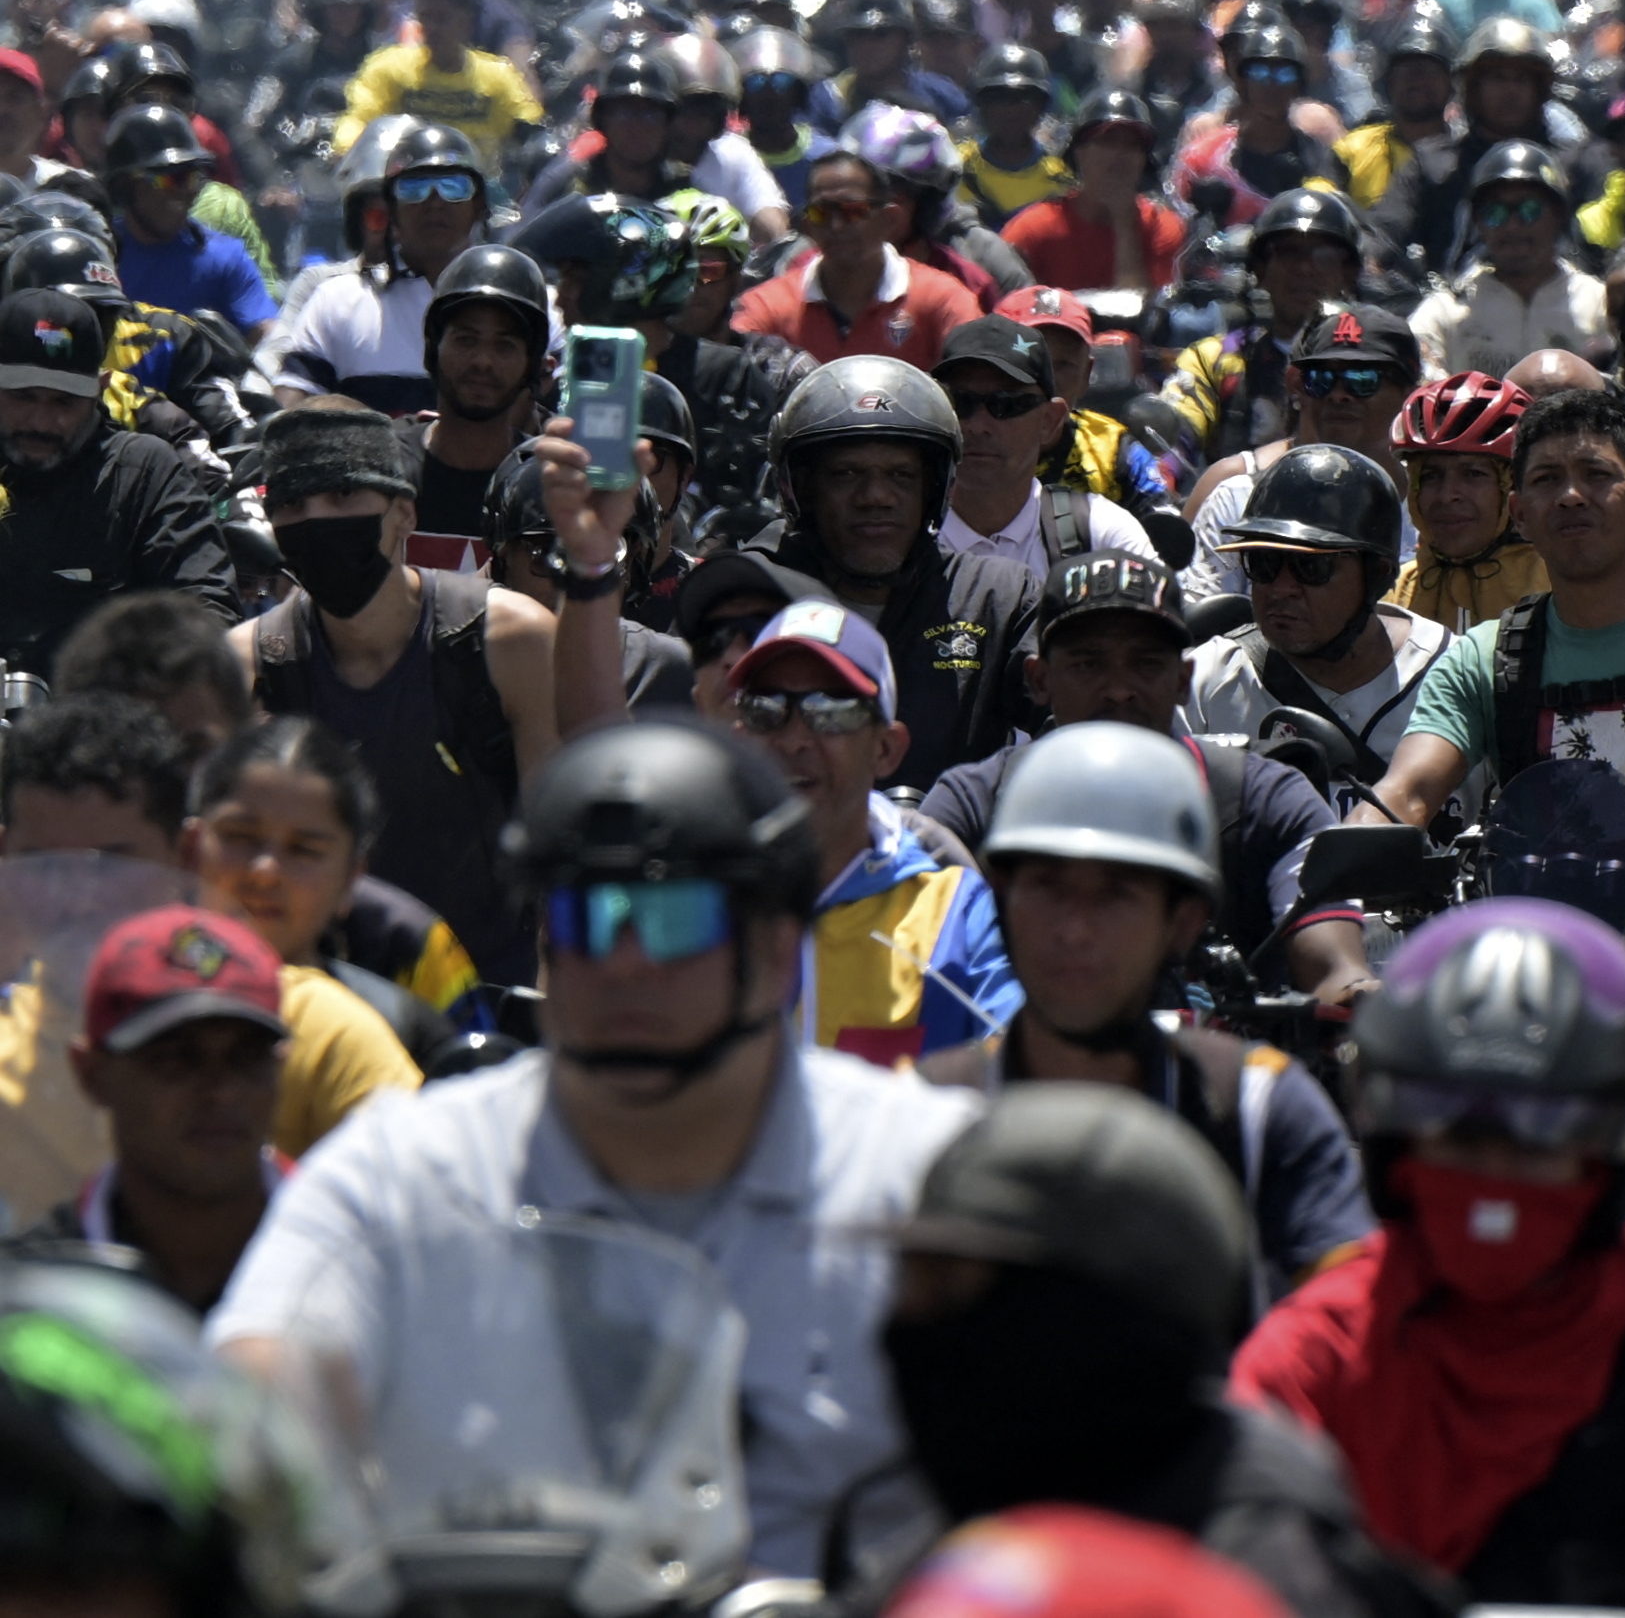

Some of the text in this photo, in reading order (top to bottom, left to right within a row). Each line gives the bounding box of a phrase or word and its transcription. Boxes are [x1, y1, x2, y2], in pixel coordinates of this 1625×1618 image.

[1333, 312, 1362, 344] LA
[1065, 559, 1168, 608] OBEY
[923, 621, 988, 640] SILVA TAXI
[933, 659, 981, 671] NOCTURNO
